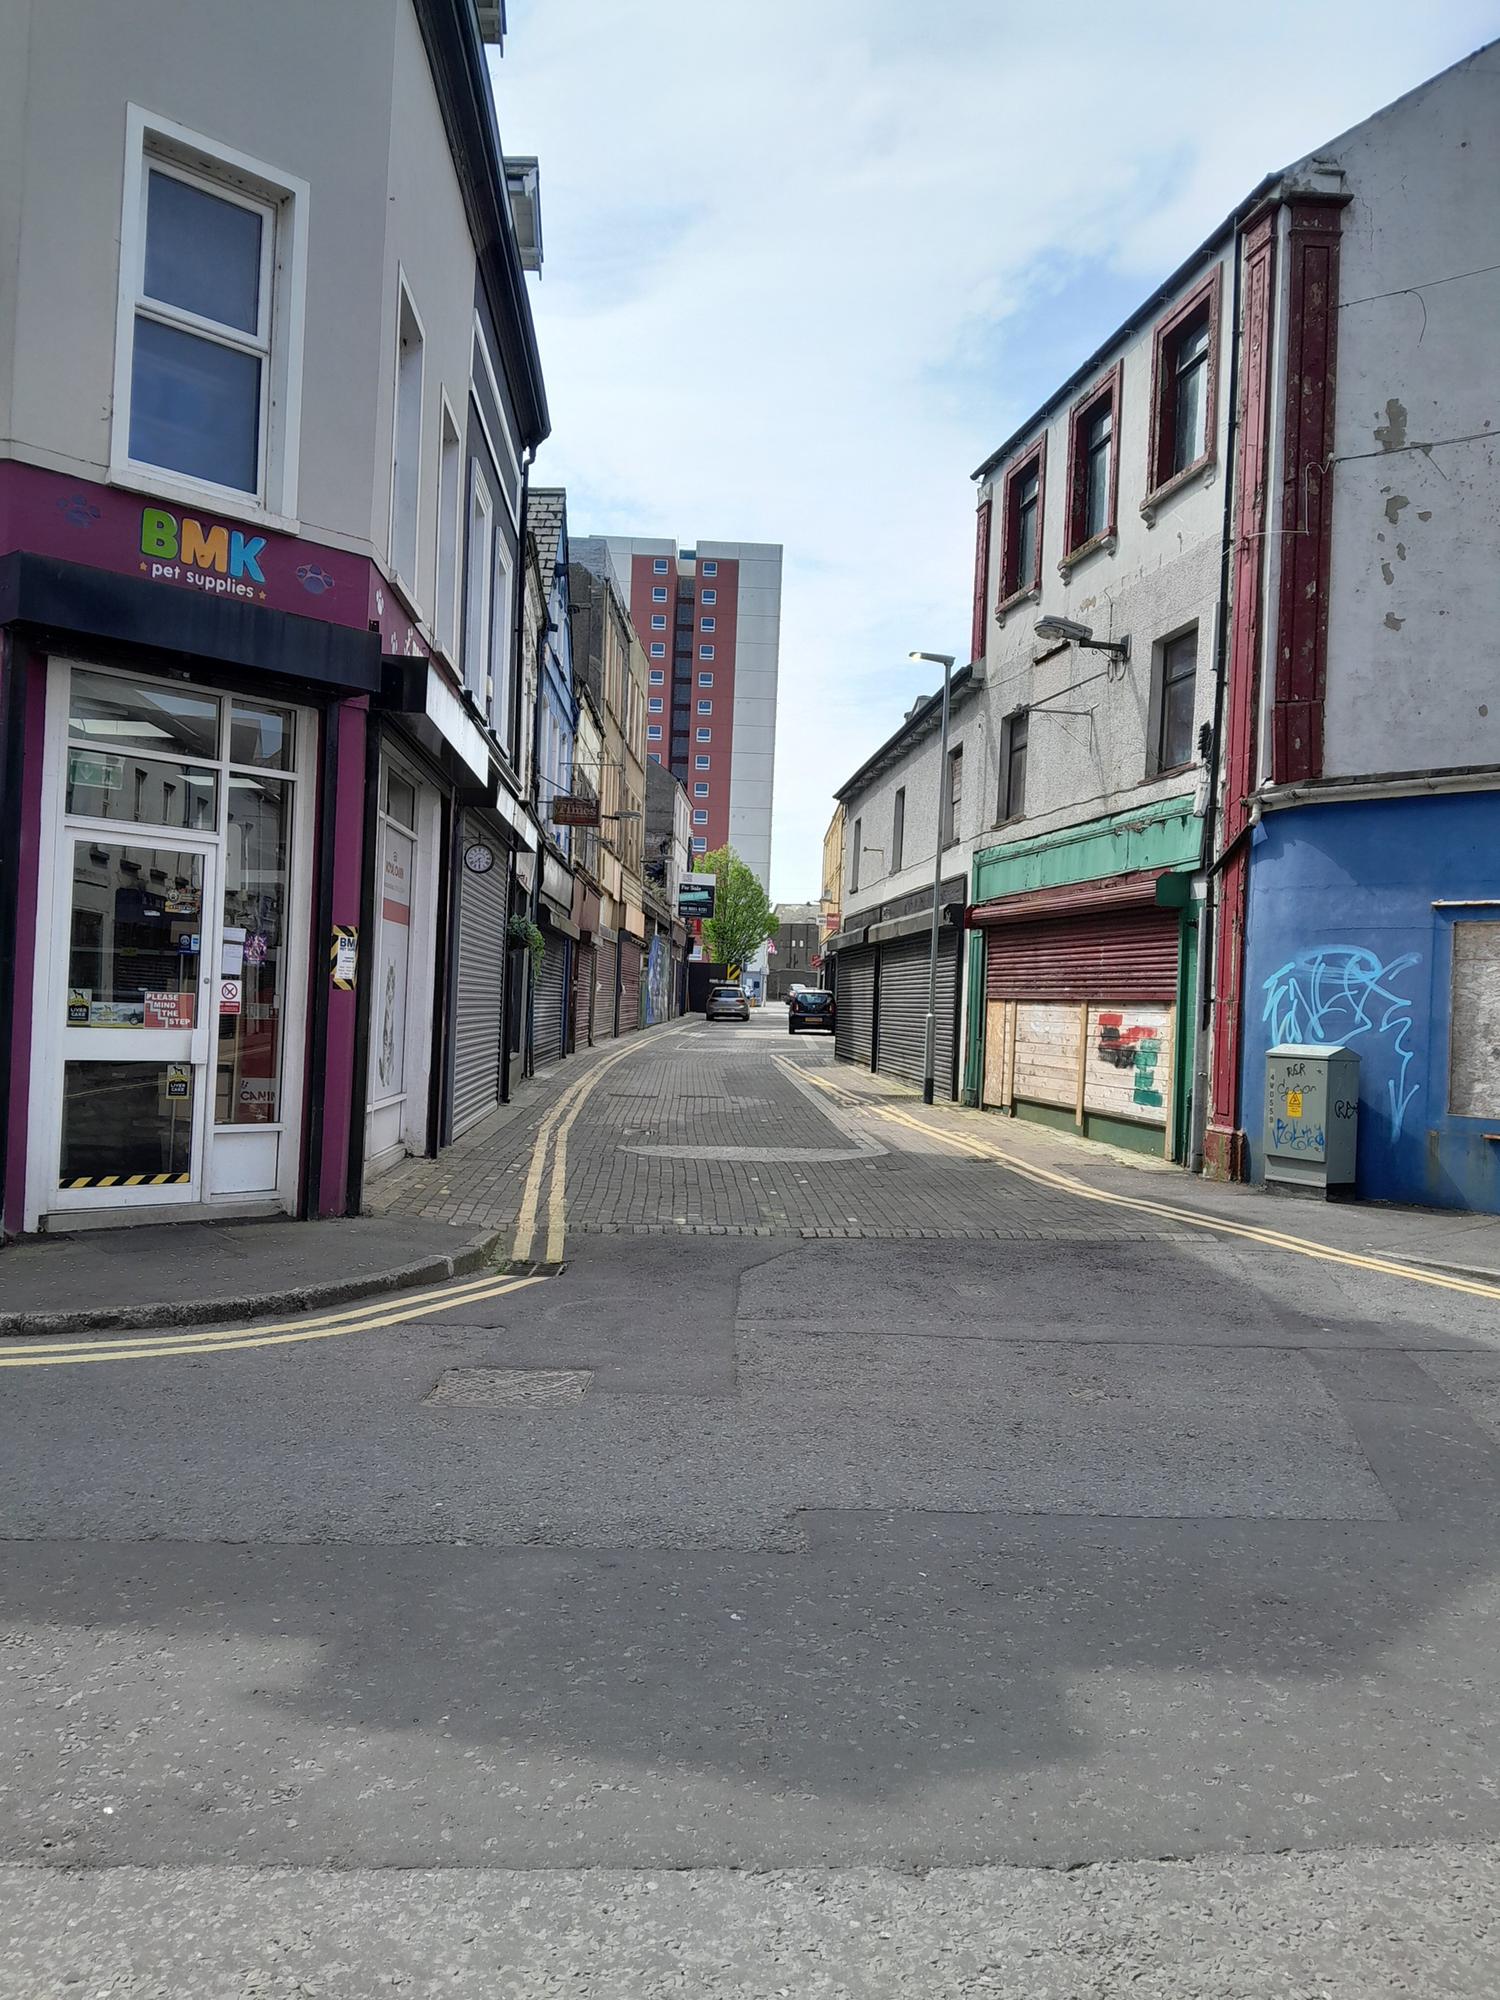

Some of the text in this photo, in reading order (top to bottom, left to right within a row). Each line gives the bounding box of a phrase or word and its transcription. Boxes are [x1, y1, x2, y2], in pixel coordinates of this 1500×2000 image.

[140, 507, 267, 583] BMK
[152, 563, 254, 598] pet supplies
[146, 993, 179, 1001] PLEASE
[154, 1001, 176, 1009] MIND
[162, 1009, 179, 1017] THE
[169, 1018, 191, 1026] STEP
